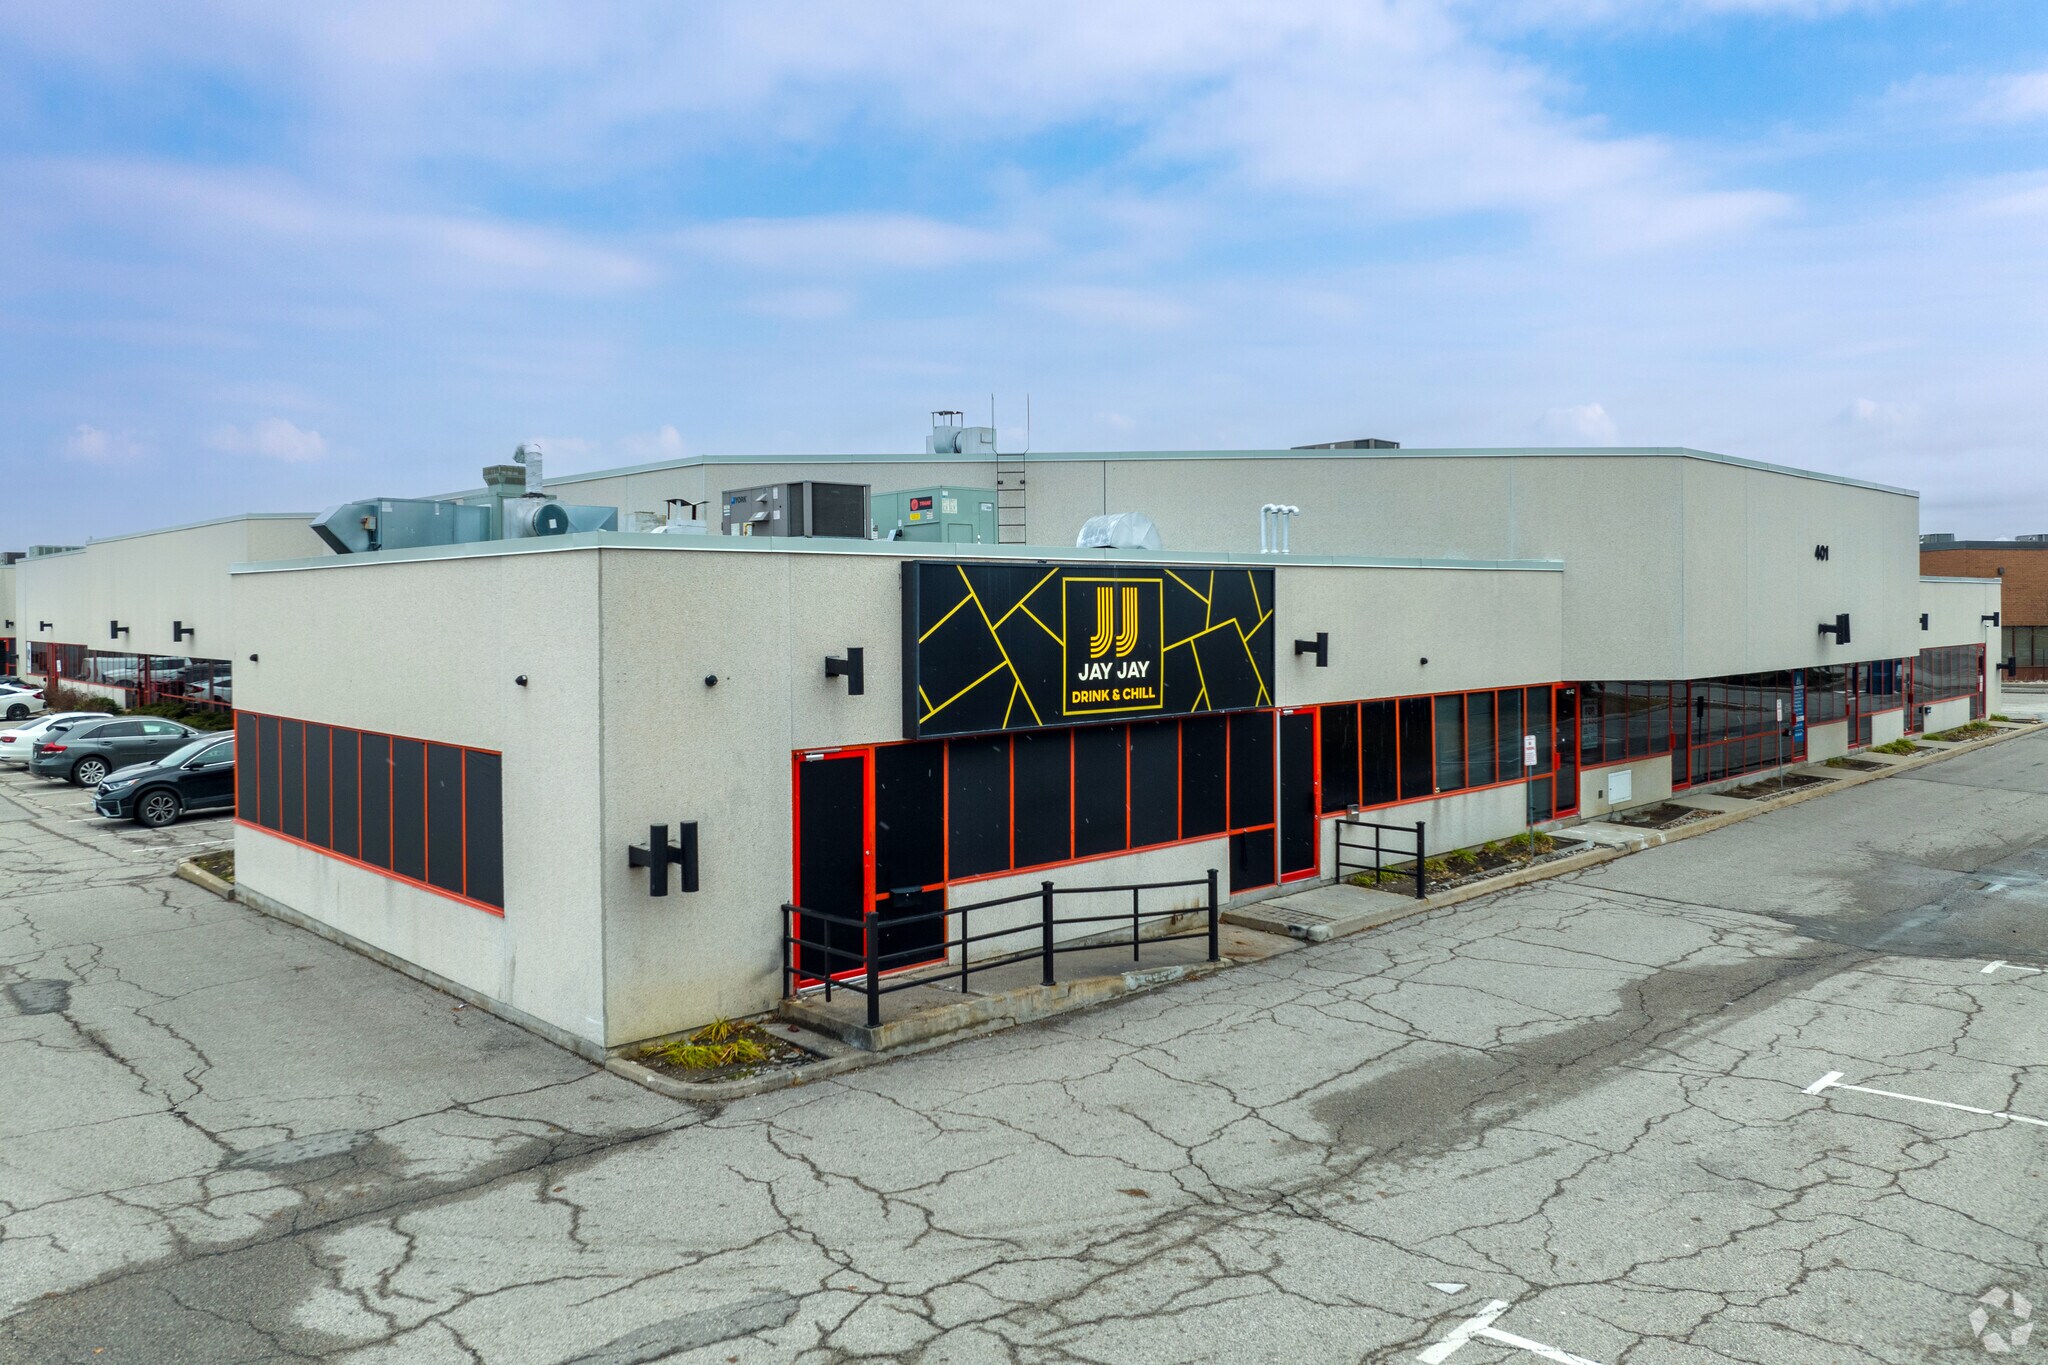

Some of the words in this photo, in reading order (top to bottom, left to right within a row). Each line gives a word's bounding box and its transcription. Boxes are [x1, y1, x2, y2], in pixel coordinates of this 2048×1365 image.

[1814, 544, 1829, 561] 401
[1090, 587, 1138, 658] JJ
[1078, 662, 1113, 681] JAY
[1117, 661, 1150, 679] JAY
[1072, 689, 1110, 703] DRINK
[1112, 688, 1120, 701] &
[1122, 686, 1155, 700] CHILL
